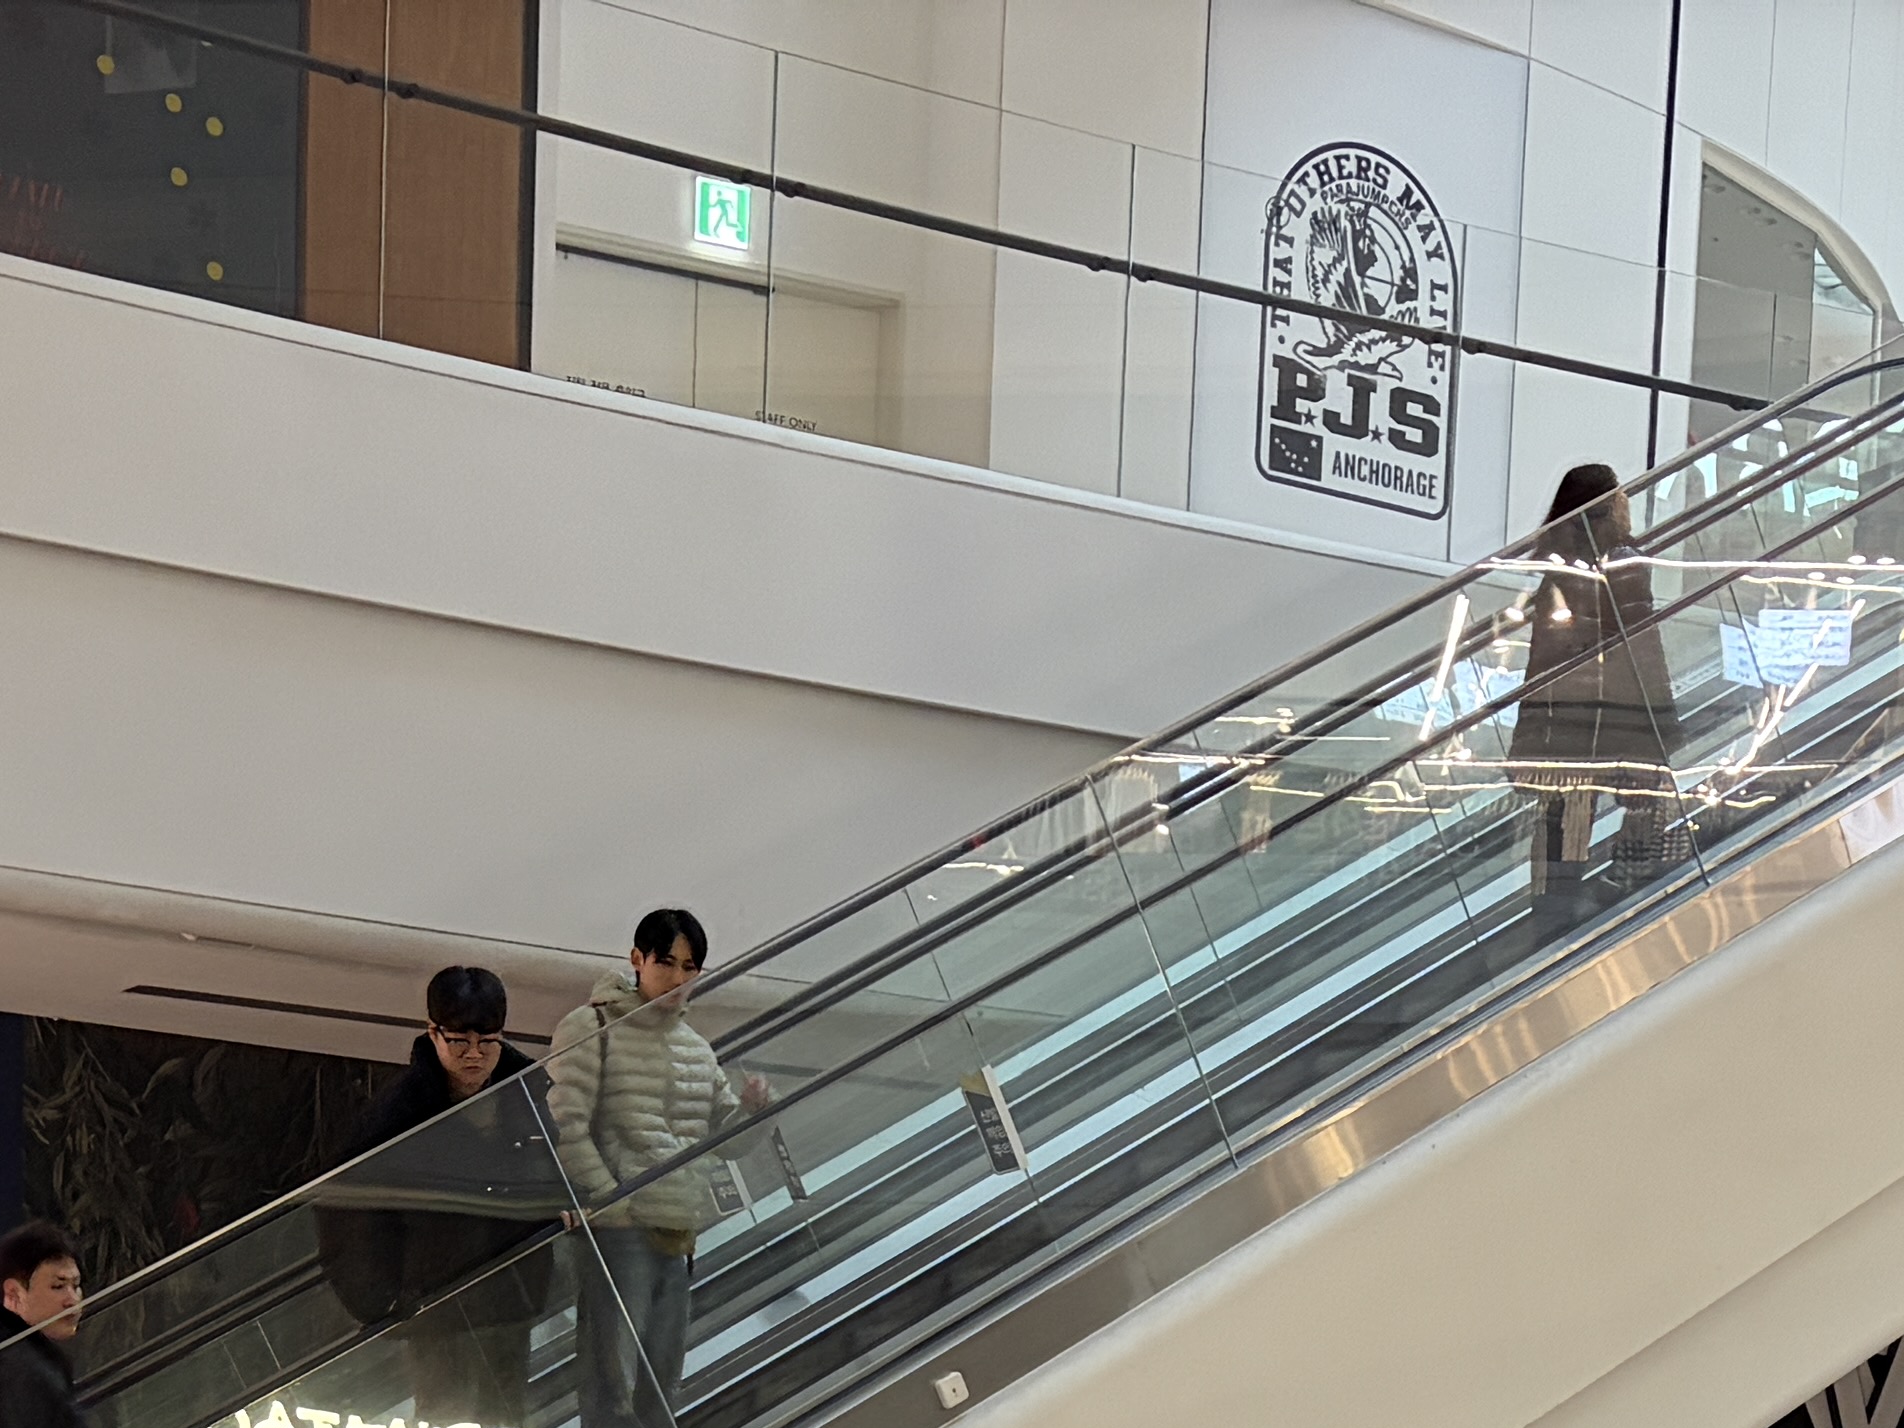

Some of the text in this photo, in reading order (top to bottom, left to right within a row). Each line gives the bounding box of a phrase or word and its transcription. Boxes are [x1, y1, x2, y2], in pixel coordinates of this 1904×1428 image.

[1290, 153, 1391, 218] OTHERS
[1398, 182, 1446, 263] MAY
[1426, 278, 1449, 373] LIE
[1332, 450, 1438, 499] ANCHORAGE
